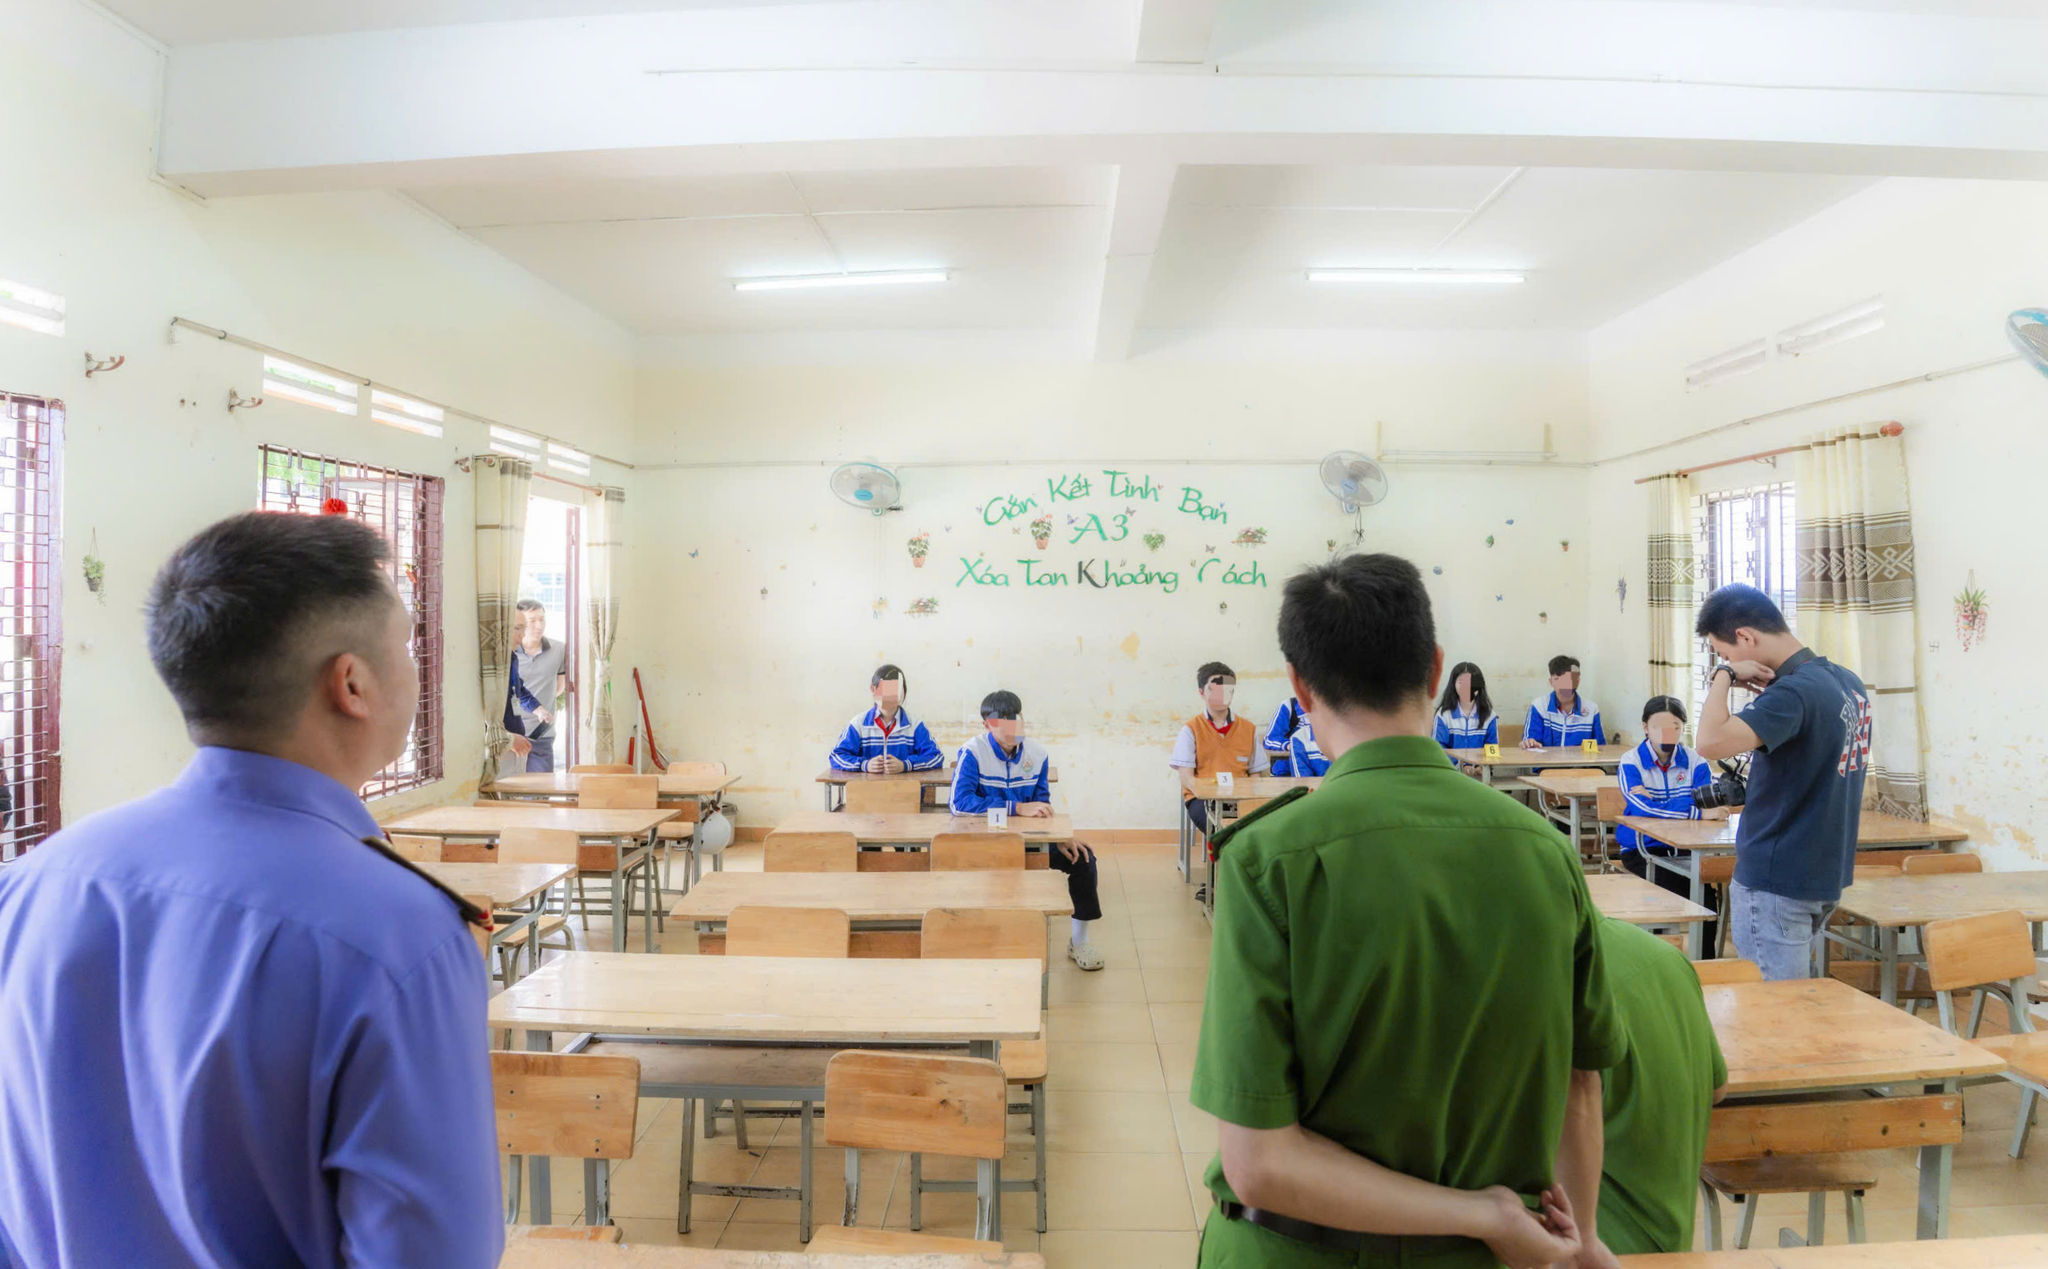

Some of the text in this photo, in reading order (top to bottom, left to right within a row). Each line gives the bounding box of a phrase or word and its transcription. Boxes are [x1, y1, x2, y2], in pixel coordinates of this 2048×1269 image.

[1047, 472, 1093, 502] Kết
[1102, 469, 1159, 502] Tình
[1177, 486, 1228, 525] Bạn
[1069, 513, 1129, 544] A3
[955, 557, 1010, 587] Xóa
[1016, 558, 1068, 587] Tan
[1077, 558, 1179, 594] Khoảng
[1489, 745, 1496, 755] 6
